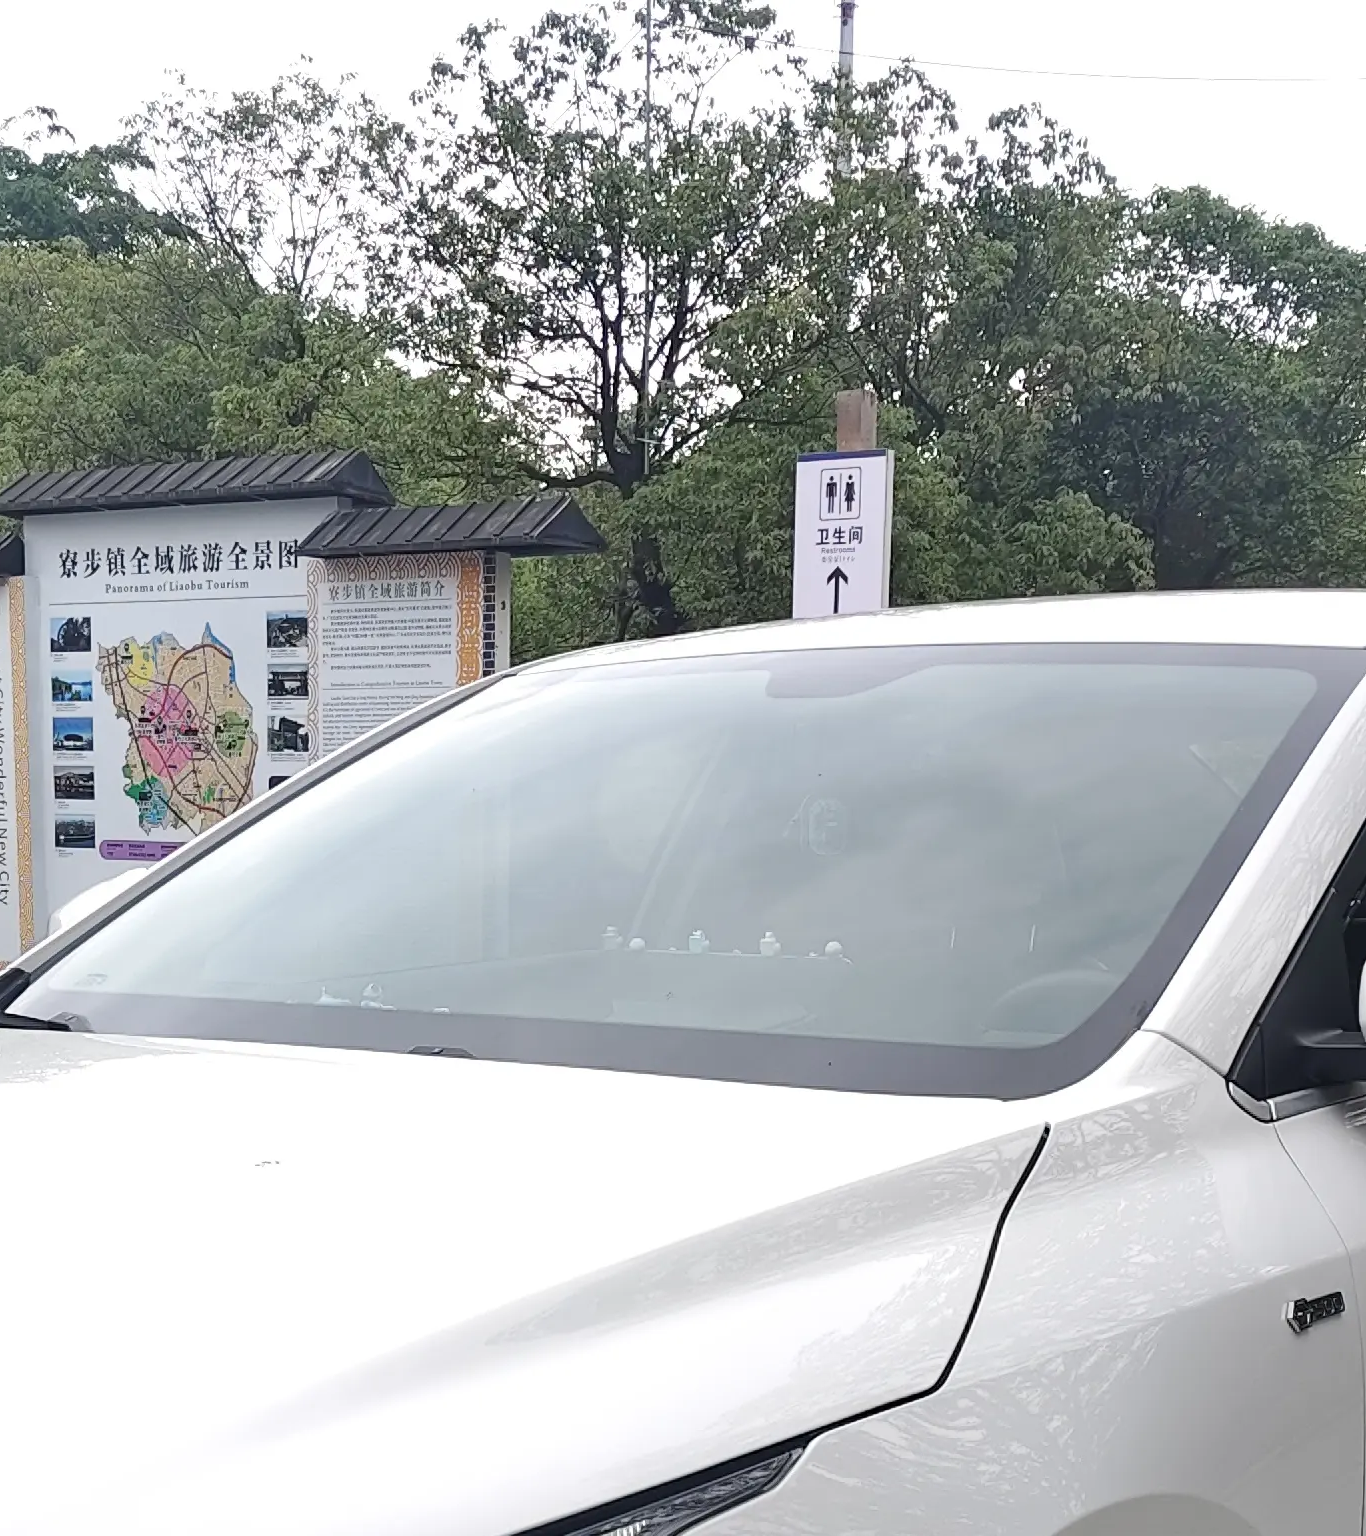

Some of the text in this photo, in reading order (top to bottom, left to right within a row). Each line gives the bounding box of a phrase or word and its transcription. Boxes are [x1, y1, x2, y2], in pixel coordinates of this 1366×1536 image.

[816, 526, 863, 546] 卫生间
[58, 539, 299, 579] 寮步镇全域旅游全景图
[105, 579, 250, 594] Panorama of Liaobu Tourism
[328, 580, 445, 601] 寮步镇全域旅游简介
